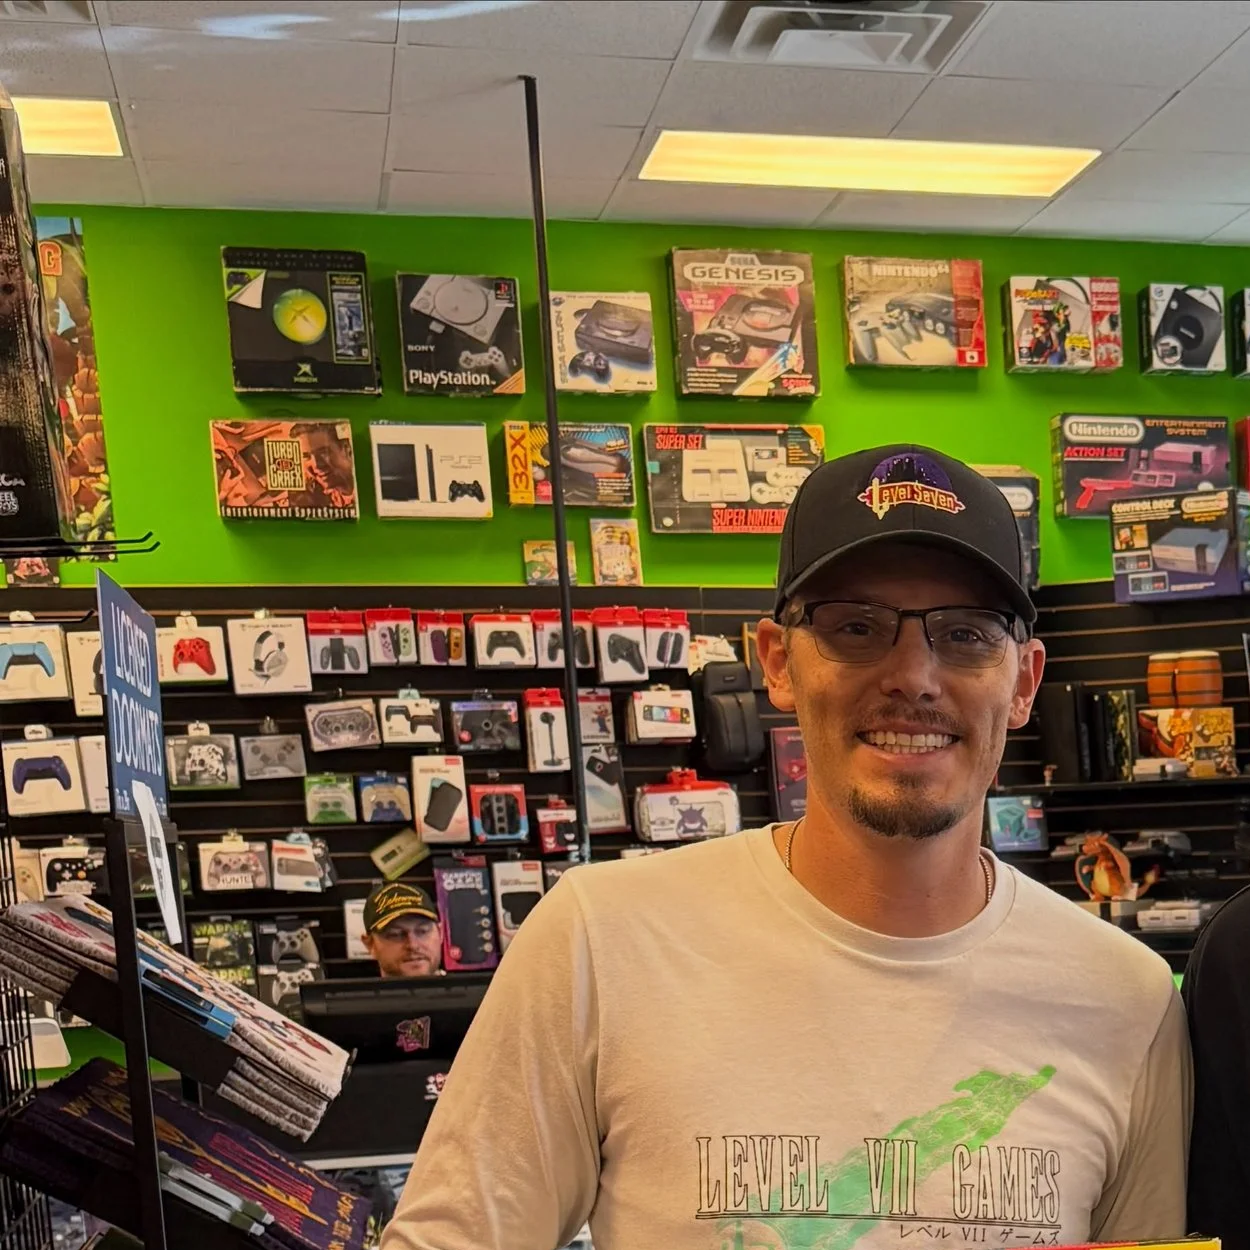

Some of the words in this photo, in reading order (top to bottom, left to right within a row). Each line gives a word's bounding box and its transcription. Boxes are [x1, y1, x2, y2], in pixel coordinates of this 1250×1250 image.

[691, 266, 797, 281] GENESIS
[871, 264, 938, 278] NINTENDO
[407, 344, 436, 352] SONY
[409, 369, 491, 389] PlayStation
[1070, 422, 1138, 436] Nintendo
[655, 434, 686, 450] SUPER
[687, 433, 704, 449] SET
[268, 441, 301, 464] TURBO
[439, 454, 485, 465] PS2
[510, 432, 530, 490] 32X
[1065, 446, 1106, 458] ACTION
[1107, 447, 1126, 458] SET
[270, 463, 303, 488] GRAFX
[872, 478, 912, 515] Level
[713, 508, 746, 526] SUPER
[111, 602, 152, 698] LICENSED
[111, 688, 163, 777] DOORMATS
[696, 1135, 829, 1215] LEVEL
[864, 1137, 918, 1216] VII
[952, 1143, 1062, 1223] GAMES
[900, 1224, 951, 1239] レベル
[962, 1226, 986, 1243] VII
